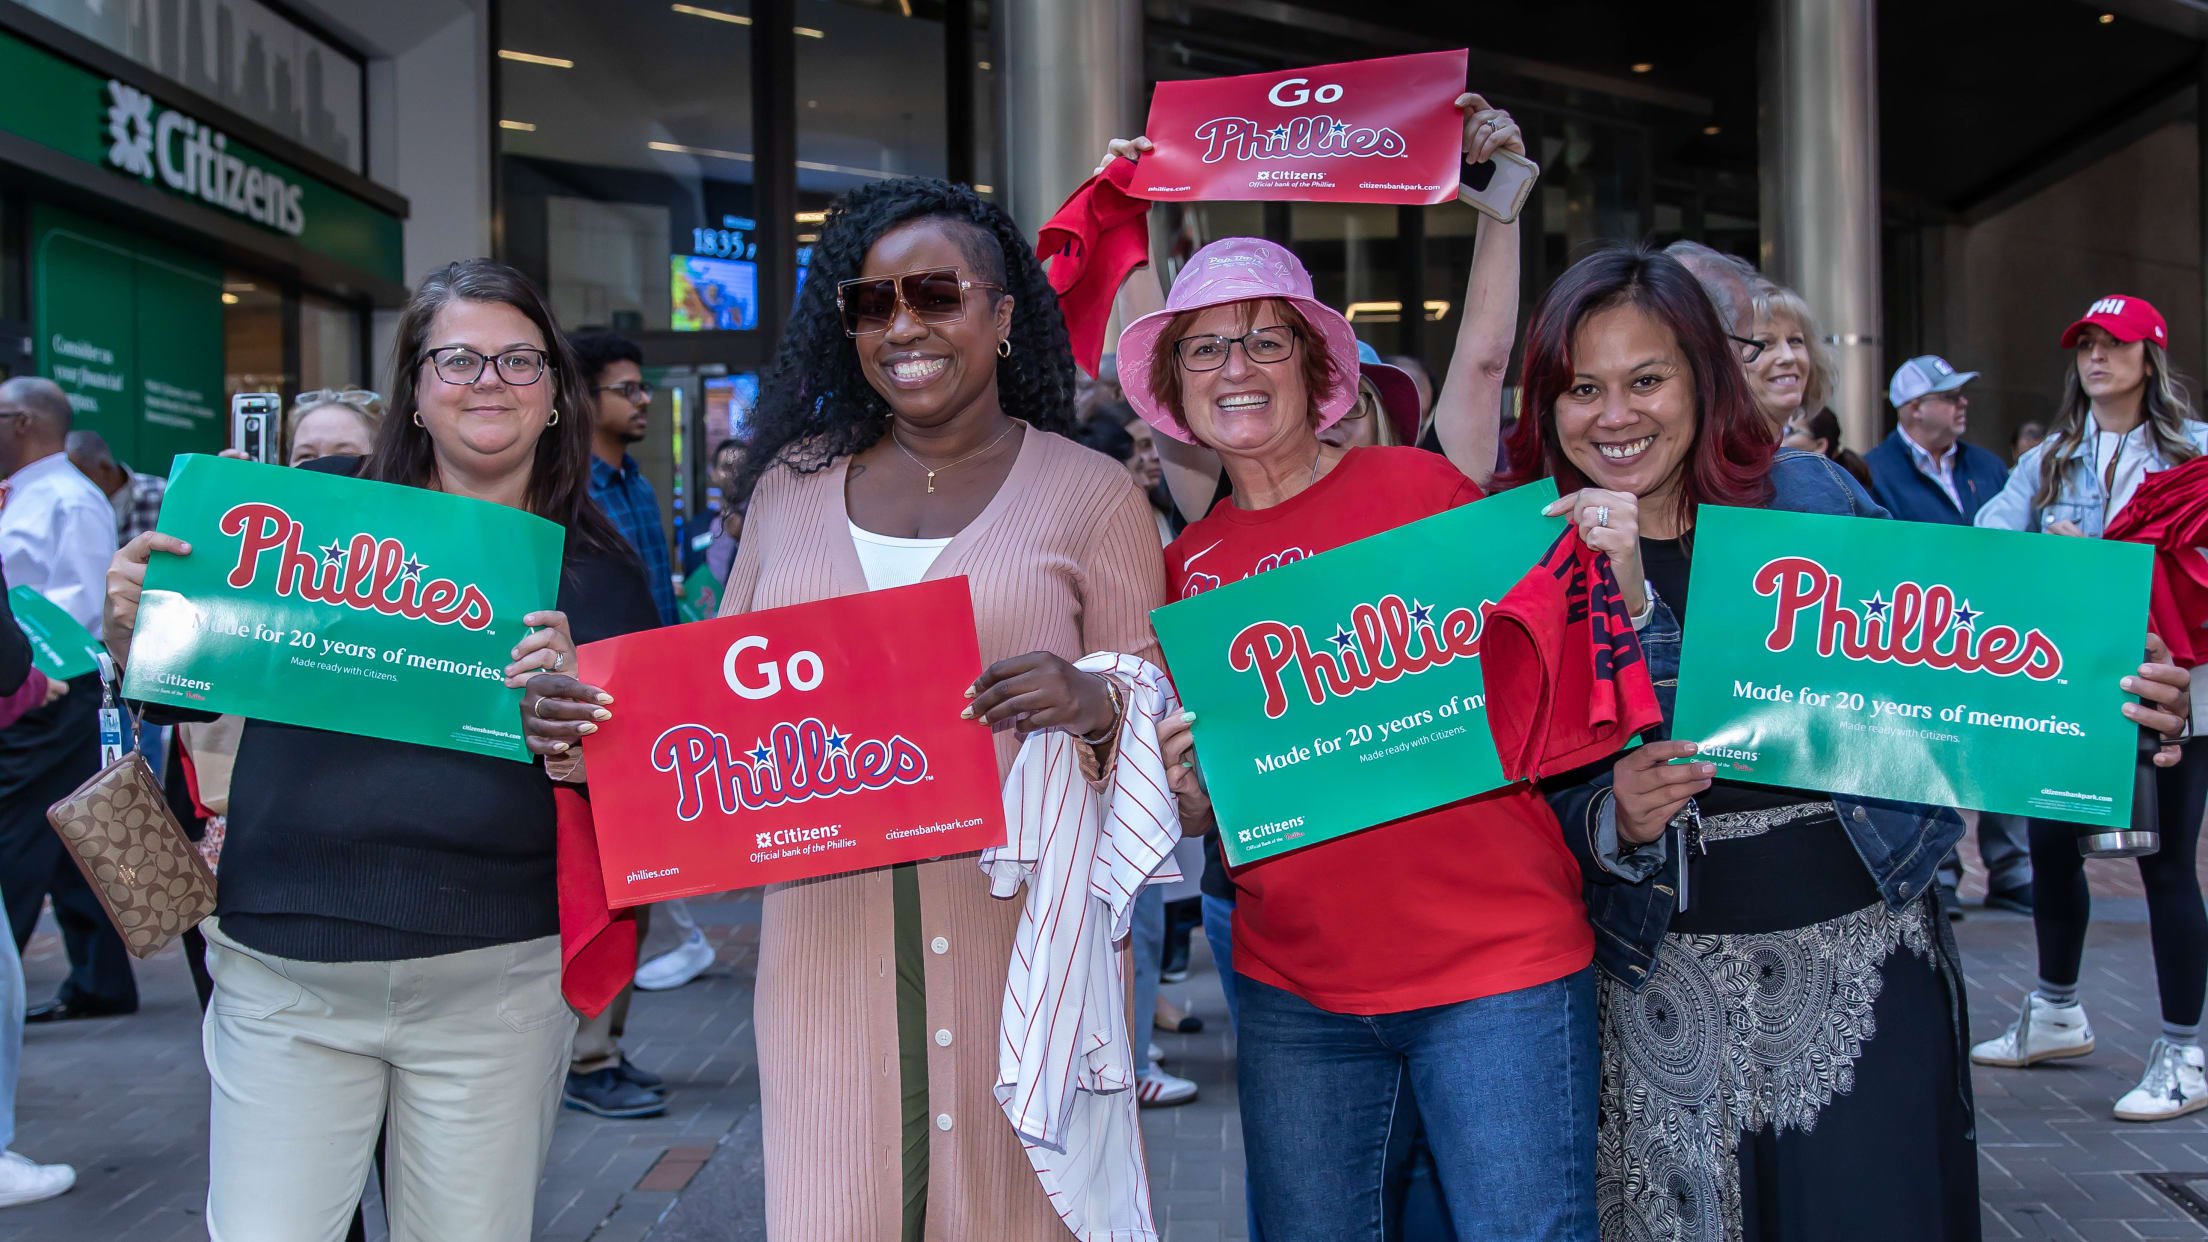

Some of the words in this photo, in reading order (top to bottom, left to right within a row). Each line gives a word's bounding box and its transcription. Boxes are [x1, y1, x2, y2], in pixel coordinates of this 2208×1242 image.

[1267, 78, 1344, 107] Go
[1195, 115, 1406, 164] Phillies
[155, 111, 306, 237] Citizens
[1271, 170, 1325, 180] Citizens
[1358, 181, 1441, 192] citizensbankpark.com
[2086, 298, 2126, 319] PHI
[219, 502, 494, 632] Phillies
[1753, 556, 2063, 681] Phillies
[192, 612, 250, 638] Made
[254, 623, 285, 644] for
[288, 629, 316, 649] 20
[319, 638, 377, 660] years
[382, 647, 407, 665] of
[406, 653, 505, 682] memories.
[290, 656, 316, 669] Made
[316, 660, 342, 674] ready
[343, 665, 362, 676] with
[723, 635, 824, 700] Go
[158, 672, 212, 691] Citizens
[1732, 680, 1793, 703] Made
[1798, 687, 1831, 708] for
[1835, 691, 1865, 711] 20
[1870, 698, 1933, 720] years
[1940, 704, 1967, 723] of
[1967, 711, 2086, 737] memories.
[1254, 746, 1311, 775] Made
[1314, 736, 1342, 757] for
[1345, 724, 1373, 747] 20
[1377, 710, 1433, 742] years
[1438, 696, 1460, 718] of
[1839, 720, 1867, 732] Made
[1868, 723, 1897, 736] ready
[1897, 726, 1919, 738] with
[1920, 730, 1961, 743] Citizens.
[1359, 751, 1385, 764] Made
[1385, 742, 1410, 756] ready
[1410, 736, 1430, 749] with
[1430, 725, 1467, 742] Citizens.
[1703, 744, 1758, 761] Citizens
[651, 717, 928, 821] Phillies
[774, 824, 839, 845] Citizens
[885, 817, 983, 840] citizensbankpark.com
[1252, 815, 1304, 839] Citizens
[749, 850, 780, 863] Official
[782, 846, 801, 858] bank
[802, 844, 811, 855] of
[812, 843, 825, 853] the
[827, 838, 857, 850] Phillies
[626, 867, 679, 884] phillies.com
